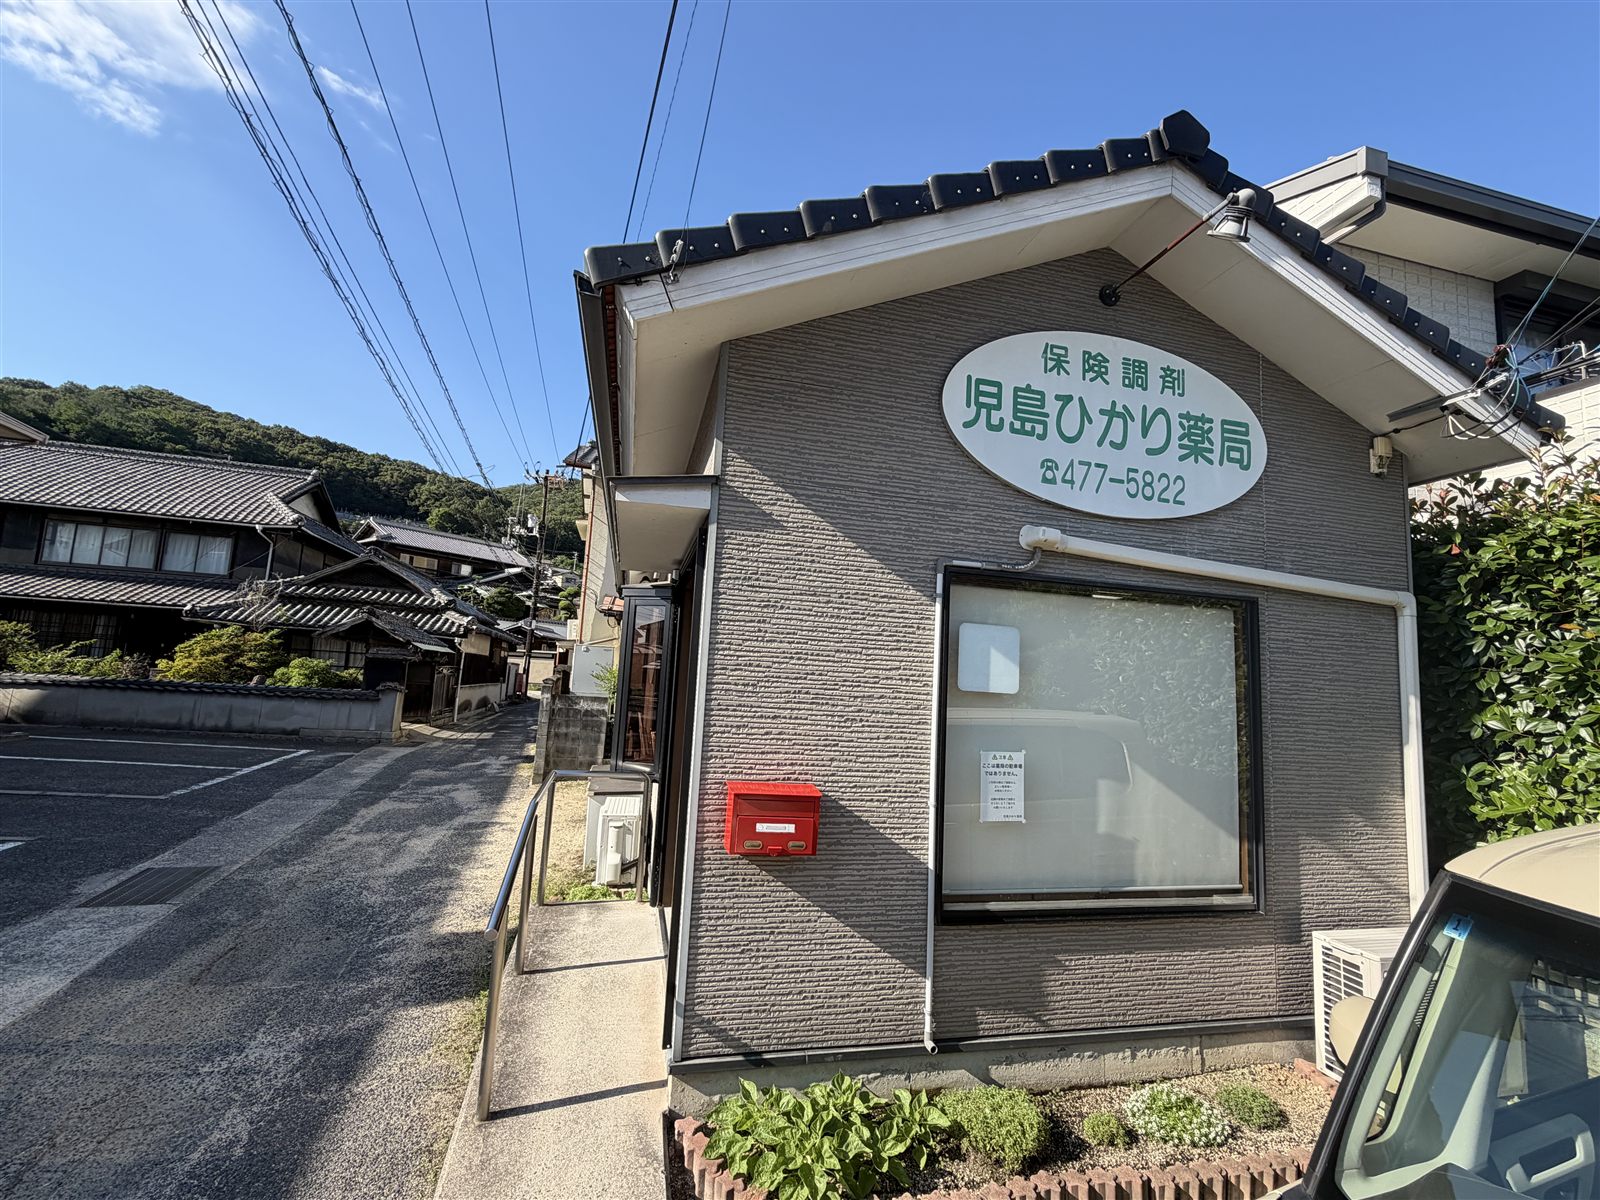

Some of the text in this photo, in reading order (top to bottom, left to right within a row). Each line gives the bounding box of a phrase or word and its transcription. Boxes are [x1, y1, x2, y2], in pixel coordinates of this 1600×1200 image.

[1041, 342, 1185, 397] 保険調剤
[962, 374, 1251, 471] 児島ひかり薬局
[1061, 458, 1186, 506] 477-5822
